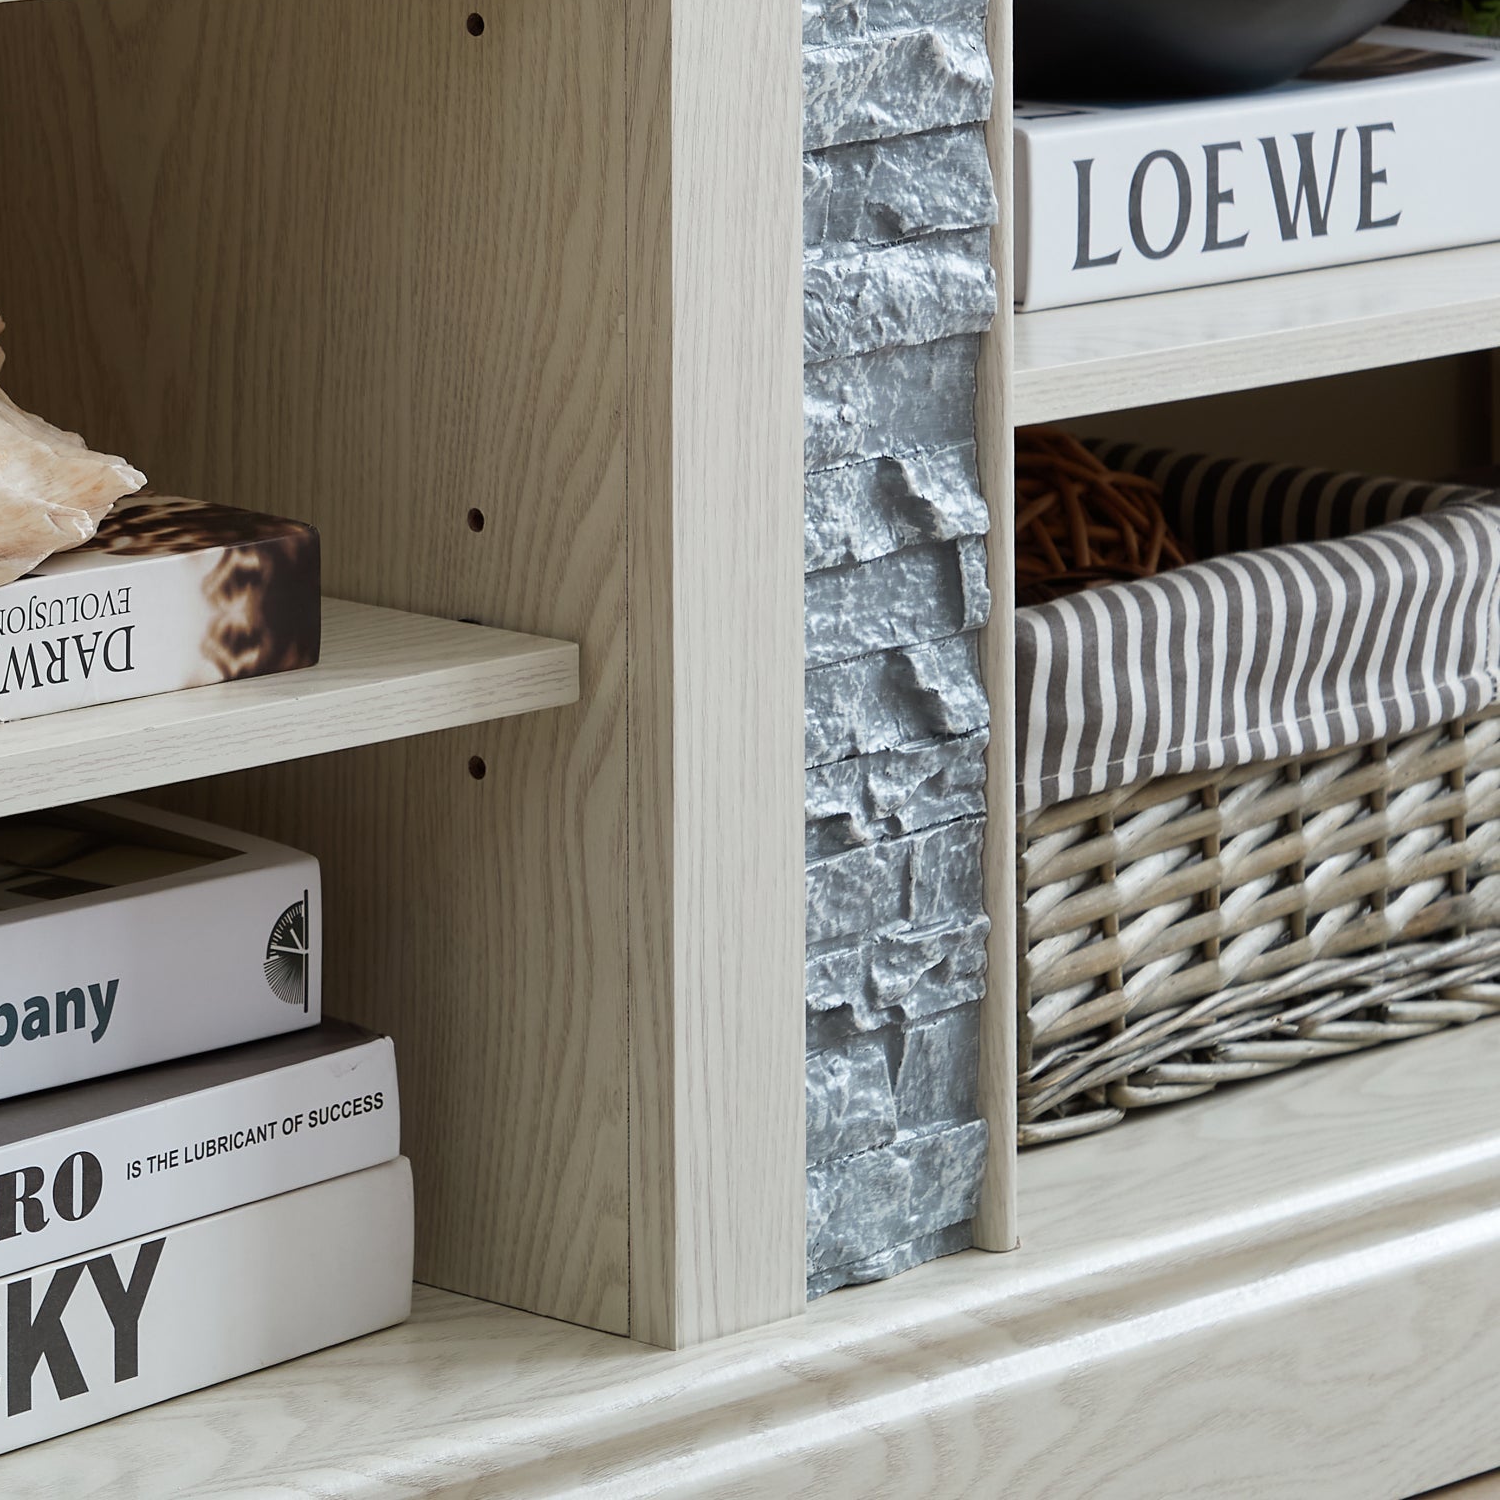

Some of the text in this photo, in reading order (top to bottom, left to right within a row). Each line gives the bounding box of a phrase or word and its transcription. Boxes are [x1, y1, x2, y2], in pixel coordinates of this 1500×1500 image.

[1072, 121, 1402, 271] LOEWE
[126, 1160, 142, 1181] IS
[146, 1149, 180, 1175] THE
[184, 1120, 278, 1165] LUBRICANT
[281, 1114, 304, 1137] OF
[308, 1091, 385, 1130] SUCCESS
